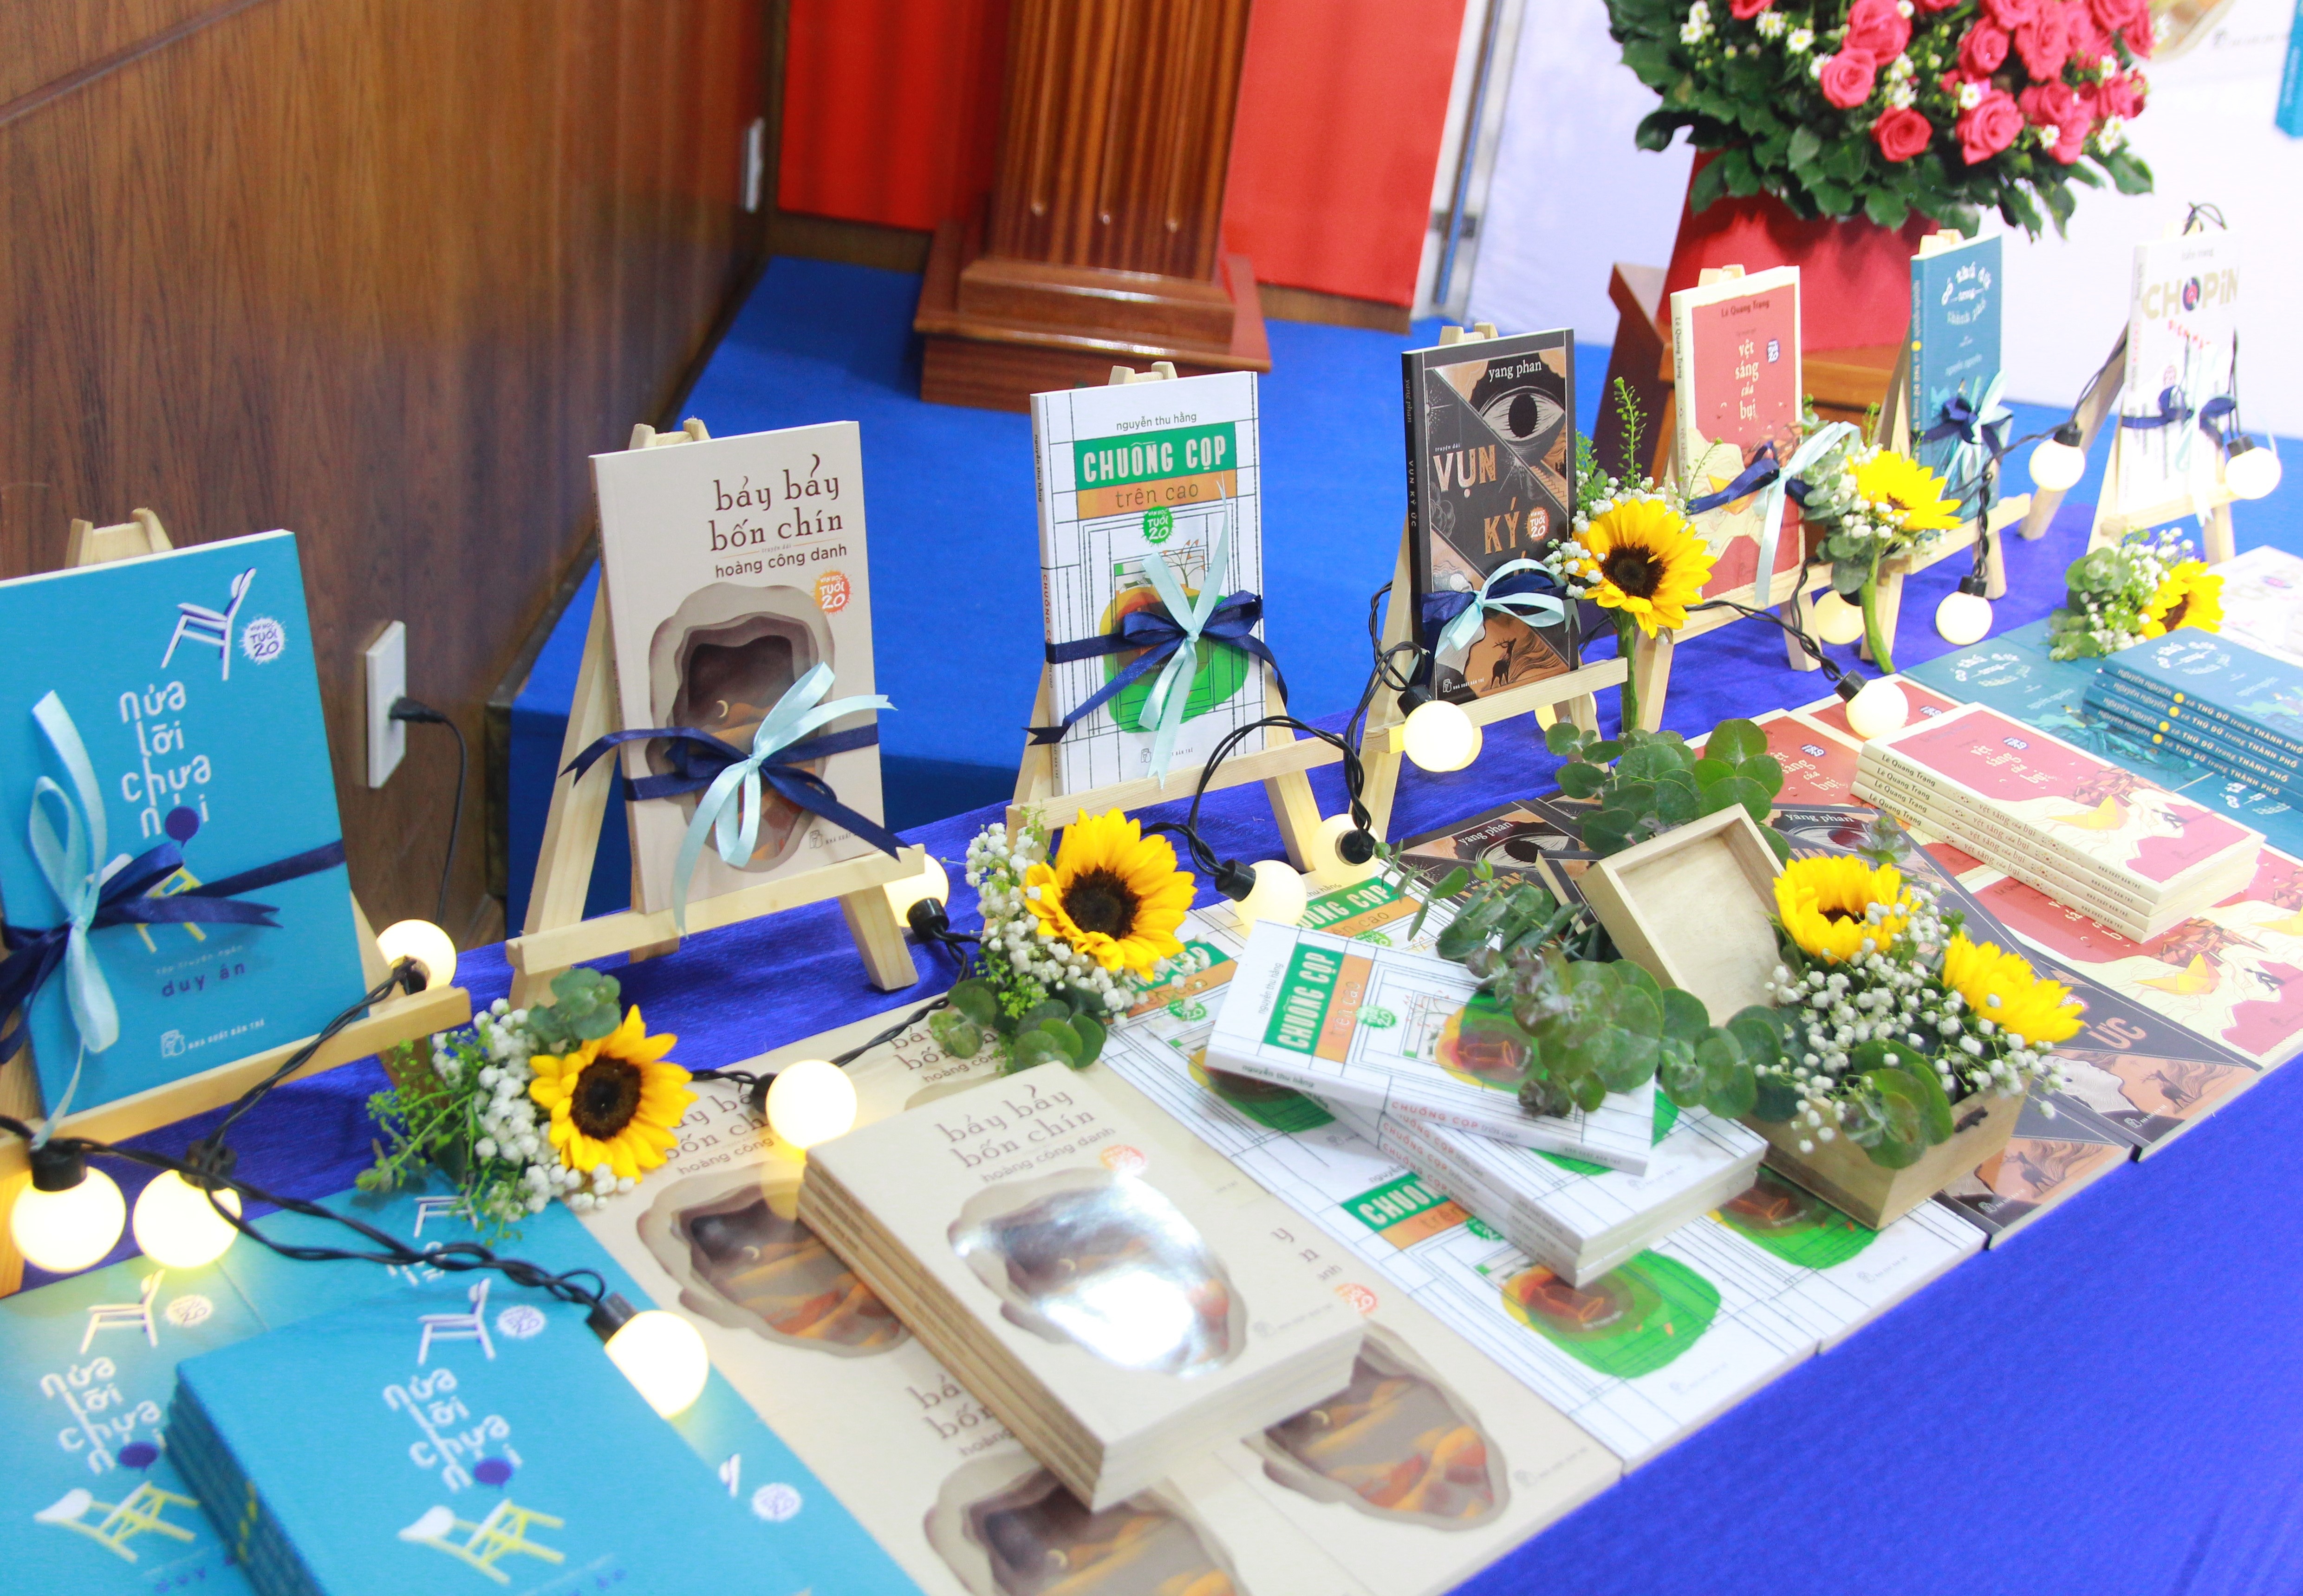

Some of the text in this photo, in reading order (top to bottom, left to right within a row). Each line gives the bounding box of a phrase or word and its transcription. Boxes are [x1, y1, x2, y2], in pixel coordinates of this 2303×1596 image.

[1489, 360, 1542, 382] yang phan
[1735, 360, 1759, 383] sáng
[1116, 411, 1197, 431] nguyễn thu hằng
[1083, 435, 1226, 483] CHUỒNG CỌP
[1433, 445, 1496, 498] VỤN
[713, 454, 839, 512] bảy bảy
[1116, 483, 1199, 509] trên cao
[708, 506, 843, 552] bốn chín
[1148, 526, 1170, 540] 20
[1484, 497, 1520, 554] KÝ
[1530, 525, 1546, 538] 20
[716, 543, 847, 577] hoàng công danh
[821, 593, 846, 610] 20
[254, 640, 280, 657] 20
[1887, 773, 1909, 790] Quang
[1986, 823, 2004, 839] sáng
[1892, 759, 1914, 776] Quang
[1992, 809, 2010, 826] sáng
[1457, 820, 1514, 845] yang phan
[1785, 813, 1855, 823] yang phan
[1879, 798, 1901, 815] Quang
[1977, 848, 1995, 865] sáng
[1884, 785, 1906, 802] Quang
[1982, 835, 2000, 852] sáng
[162, 963, 246, 996] duy ân
[1298, 951, 1338, 984] CỌP
[934, 1083, 1074, 1142] bảy bảy
[677, 1137, 774, 1175] hoàng công
[949, 1108, 1096, 1168] bốn chín
[980, 1126, 1116, 1184] hoàng công danh
